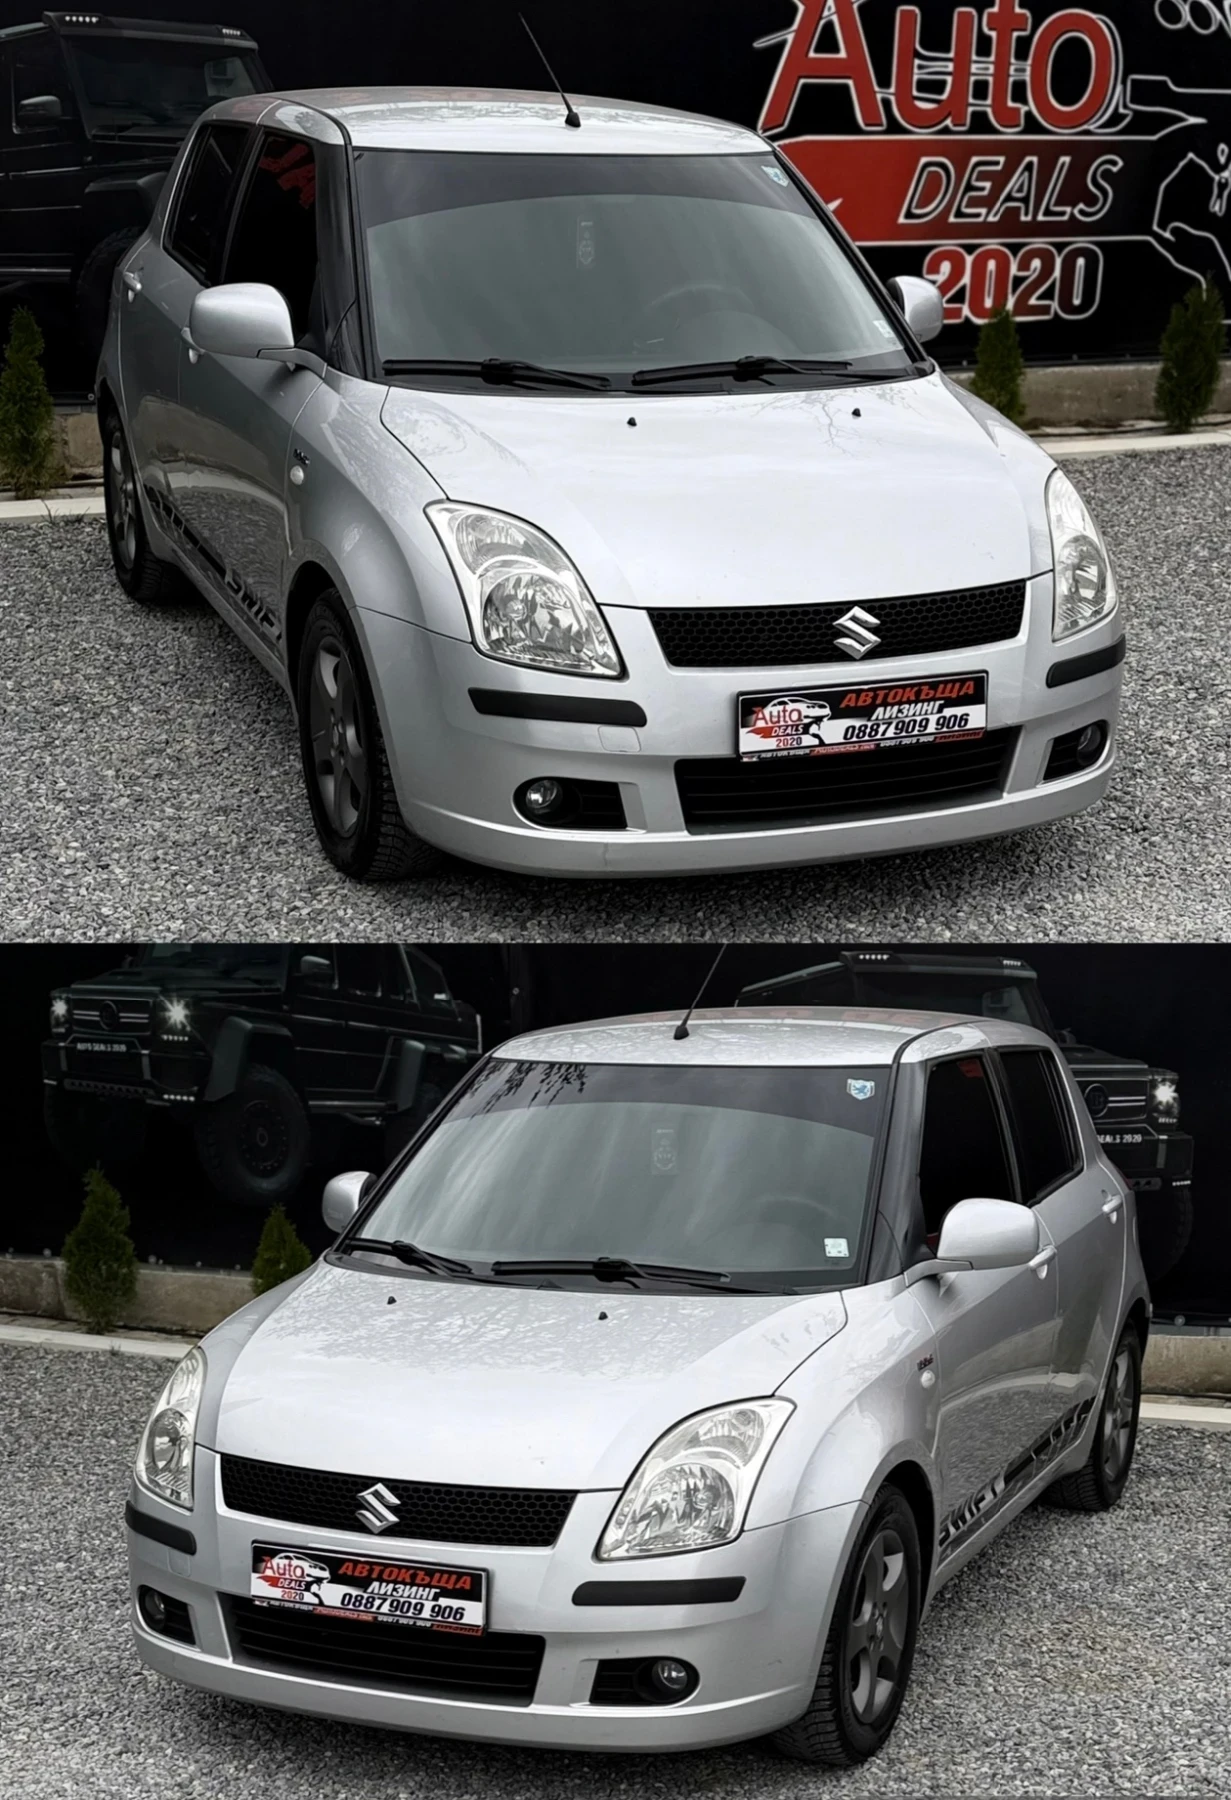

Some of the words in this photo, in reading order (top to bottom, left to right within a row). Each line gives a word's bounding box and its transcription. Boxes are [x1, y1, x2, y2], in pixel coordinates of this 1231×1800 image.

[760, 0, 1117, 132] Auto
[898, 155, 1123, 223] DEALS
[922, 243, 1103, 324] 2020
[839, 680, 975, 708] АВТОКЪЩА
[752, 706, 804, 727] Auto
[870, 700, 944, 722] ЛИЗИНГ
[771, 724, 803, 736] DEALS
[842, 721, 893, 741] 0887
[893, 716, 930, 736] 909
[934, 712, 970, 730] 906
[775, 736, 803, 748] 2020
[261, 1557, 307, 1579] Auto
[338, 1561, 472, 1590] АВТОКЪЩА
[277, 1578, 307, 1591] DEALS
[281, 1590, 305, 1601] 2020
[366, 1580, 441, 1602] ЛИЗИНГ
[340, 1592, 390, 1612] 0887
[389, 1598, 425, 1617] 909
[429, 1604, 466, 1622] 906
